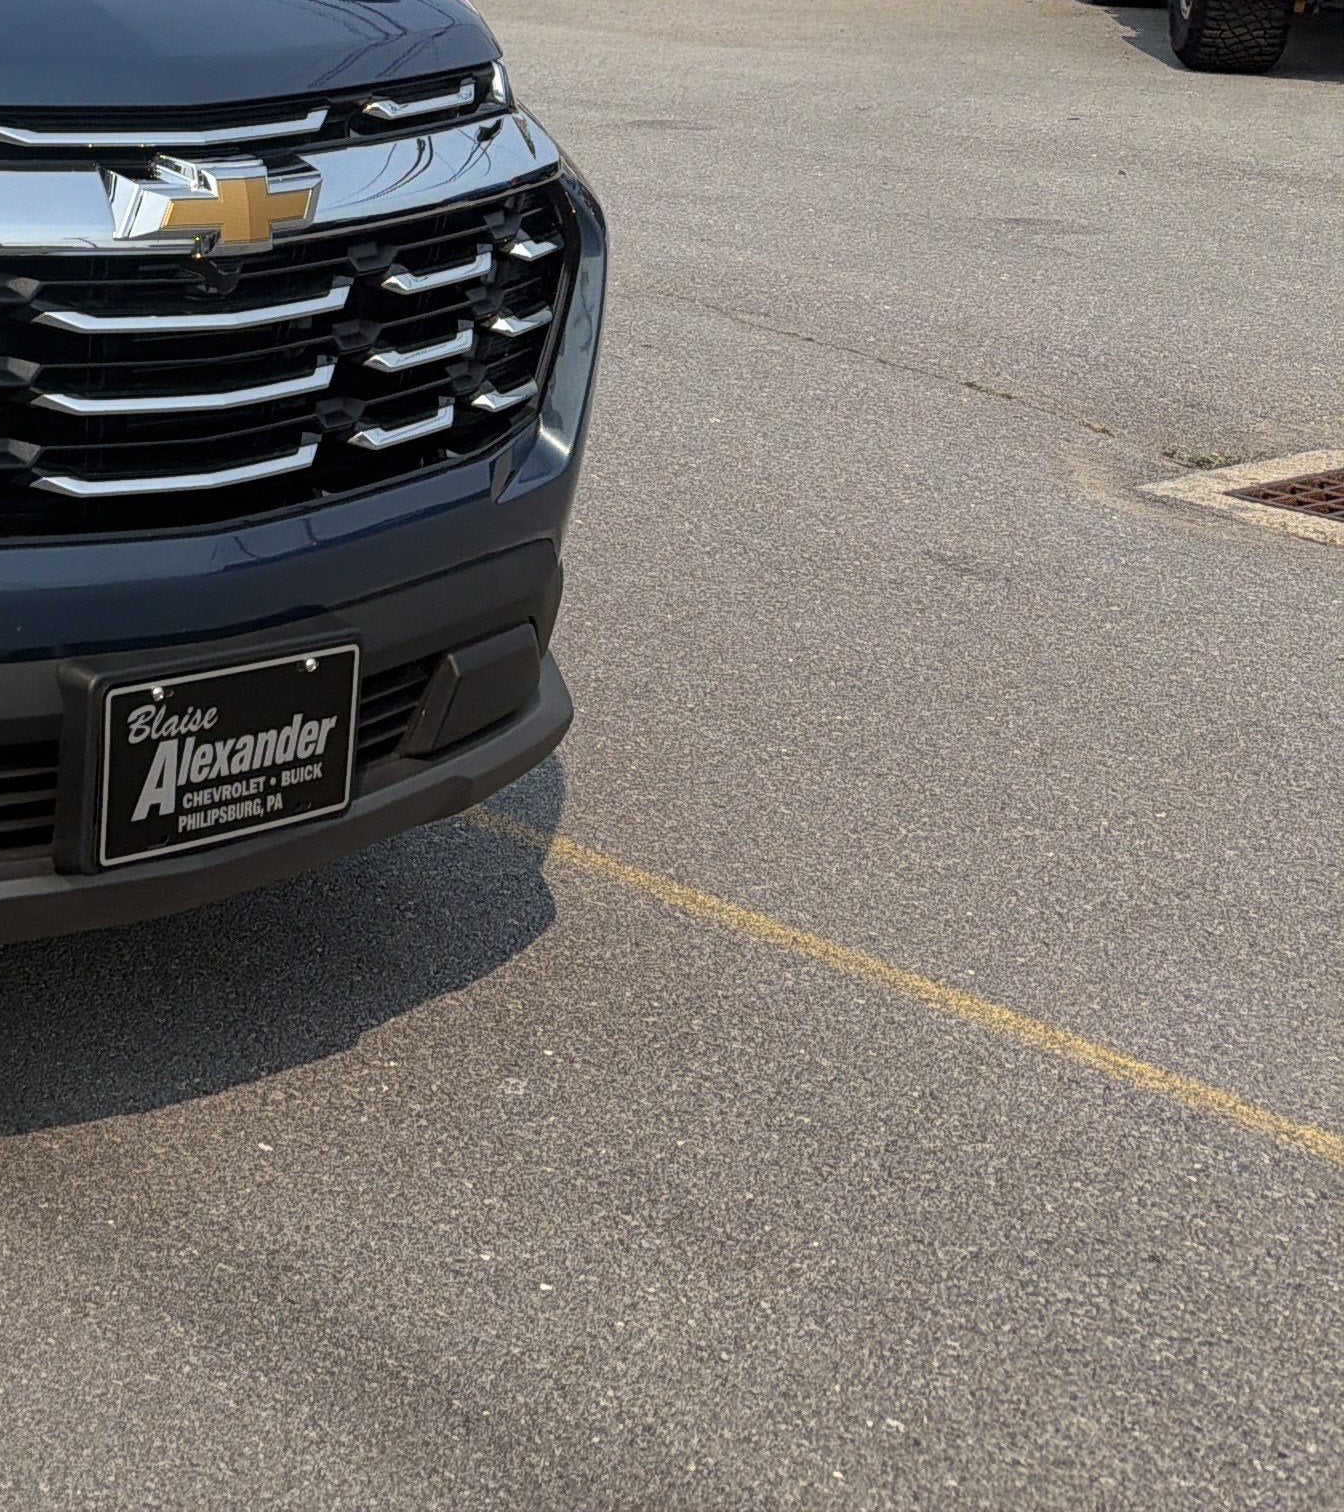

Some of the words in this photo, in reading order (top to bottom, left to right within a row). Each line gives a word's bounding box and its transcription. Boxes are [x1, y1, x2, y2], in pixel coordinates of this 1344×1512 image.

[127, 703, 219, 745] Blaise
[130, 712, 338, 823] Alexander
[182, 775, 266, 809] CHEVROLET
[280, 761, 323, 787] BUICK
[178, 798, 265, 834] PHILIPSBURG,
[266, 792, 284, 811] PA
